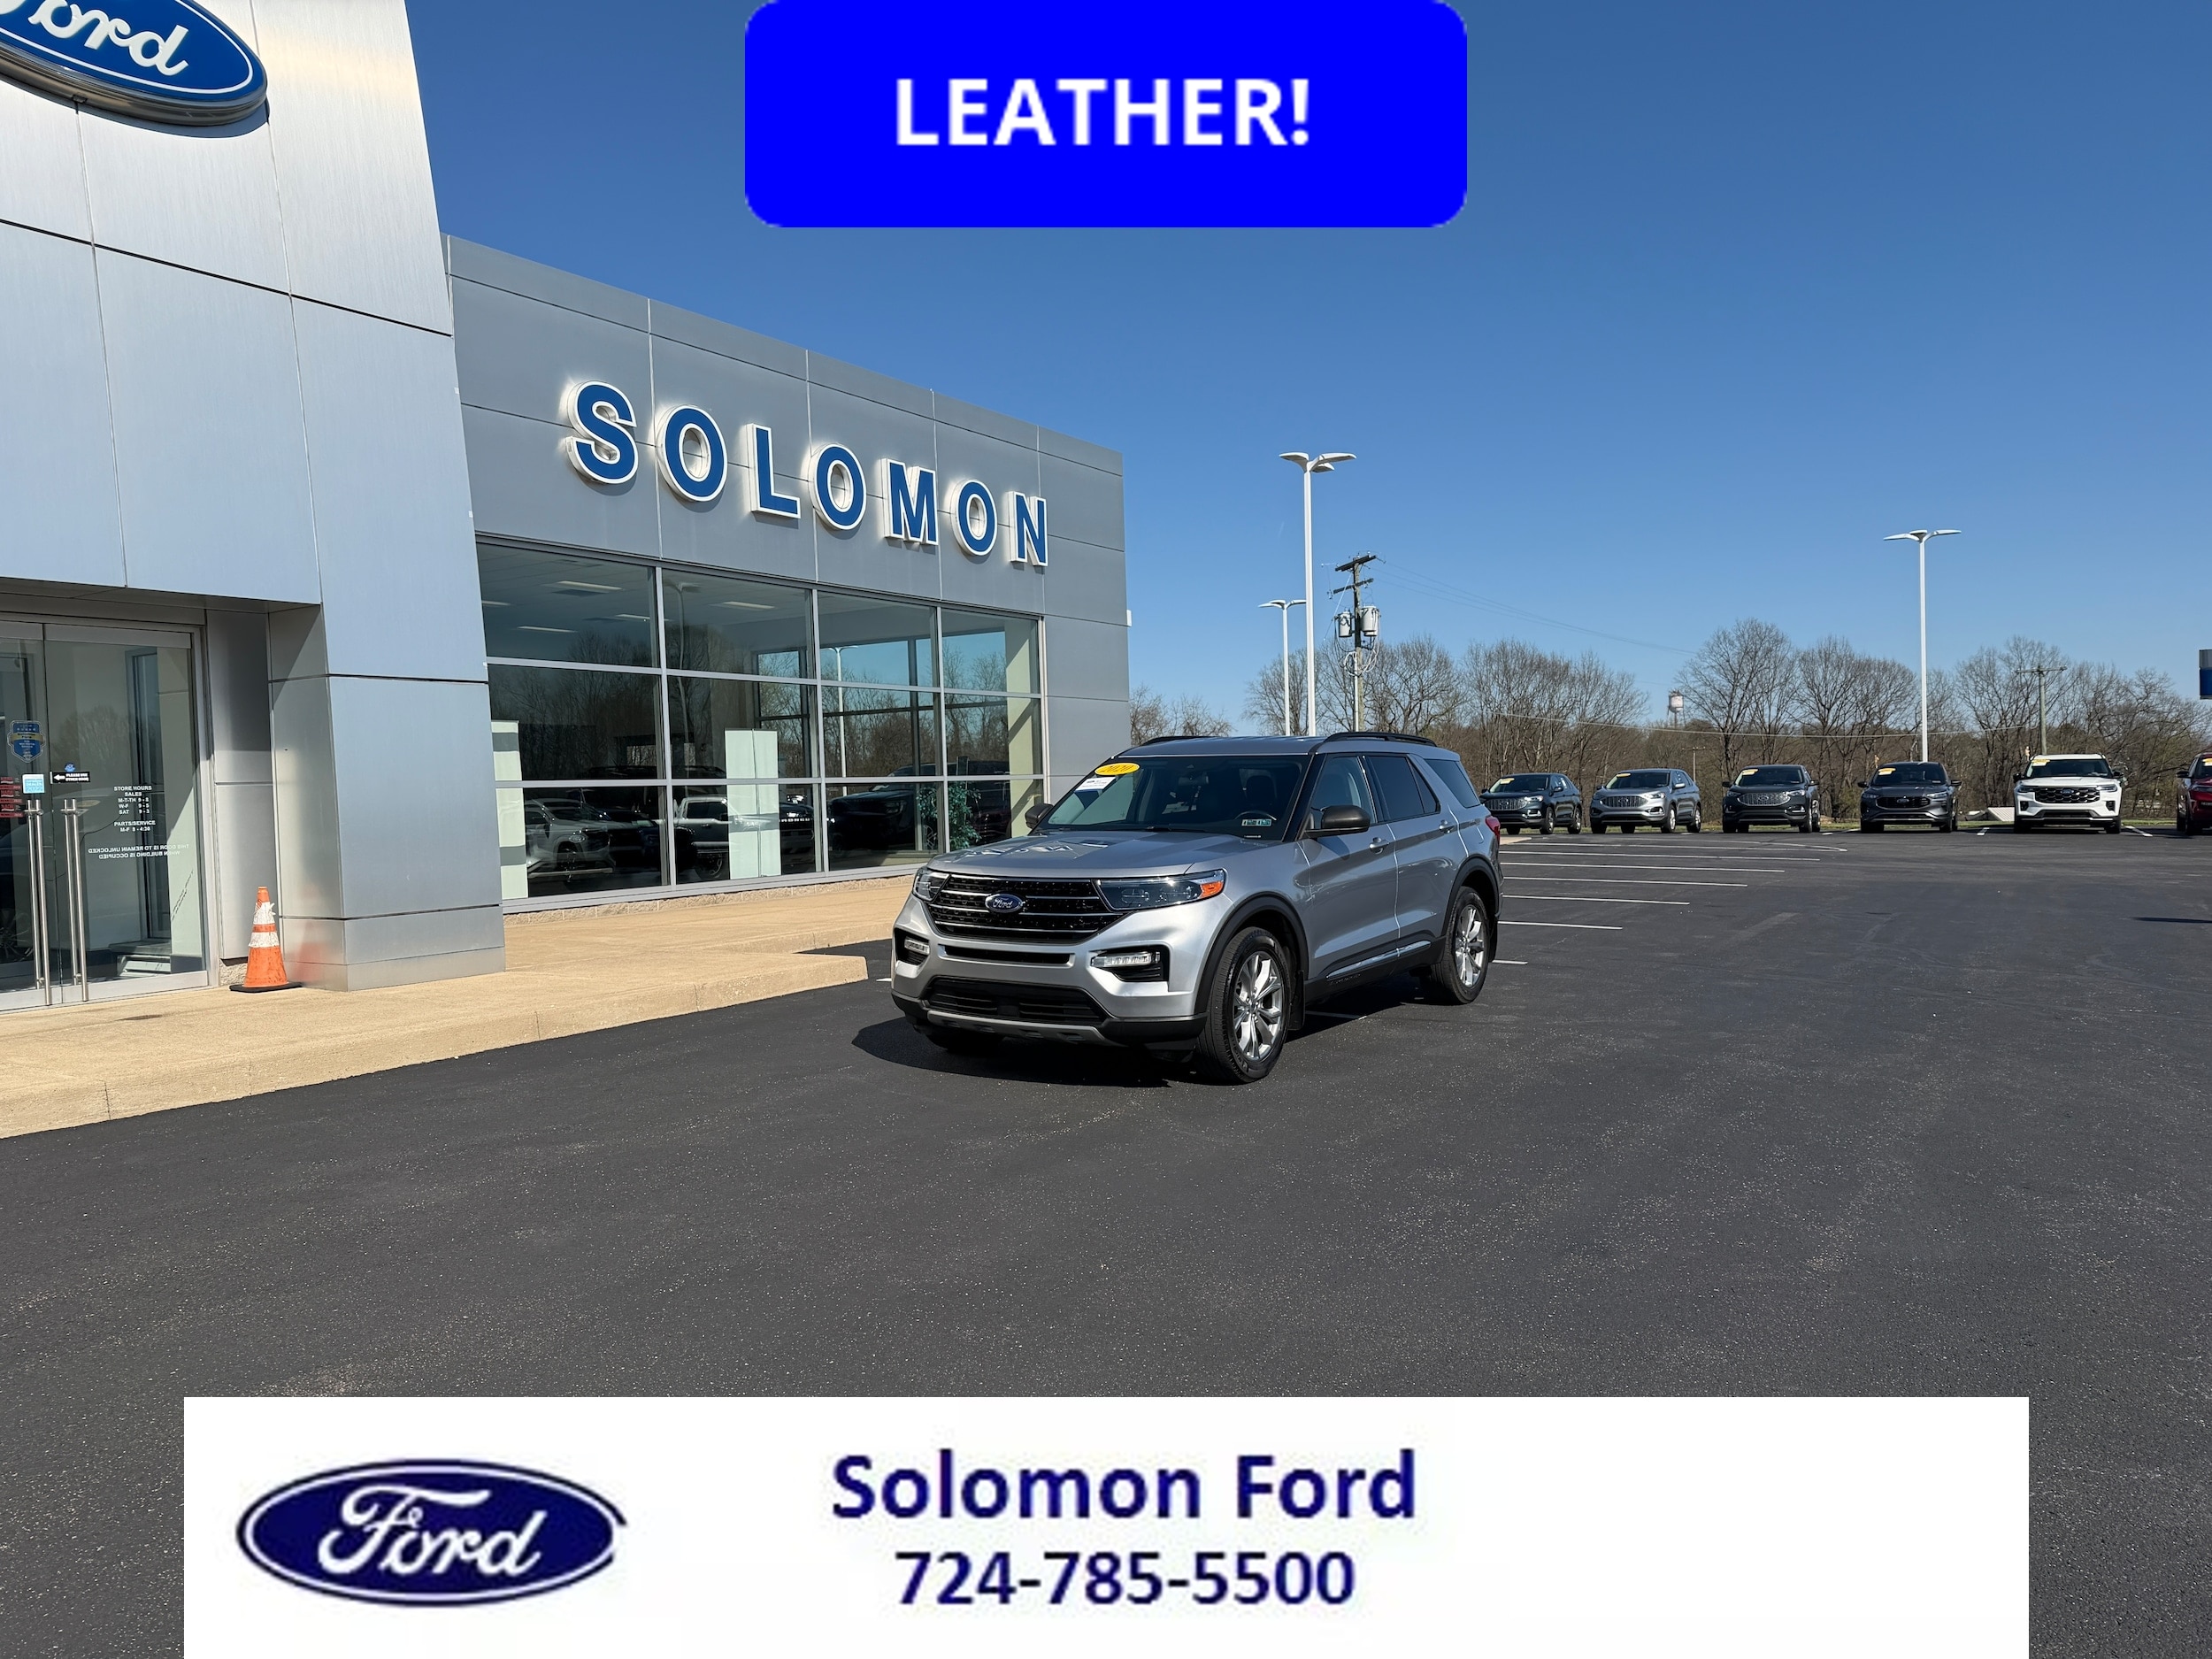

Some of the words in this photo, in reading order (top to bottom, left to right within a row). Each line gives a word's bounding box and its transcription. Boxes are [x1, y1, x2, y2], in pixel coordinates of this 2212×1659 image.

[0, 0, 189, 76] ord
[565, 380, 1048, 567] SOLOMON
[992, 897, 1014, 909] Ford
